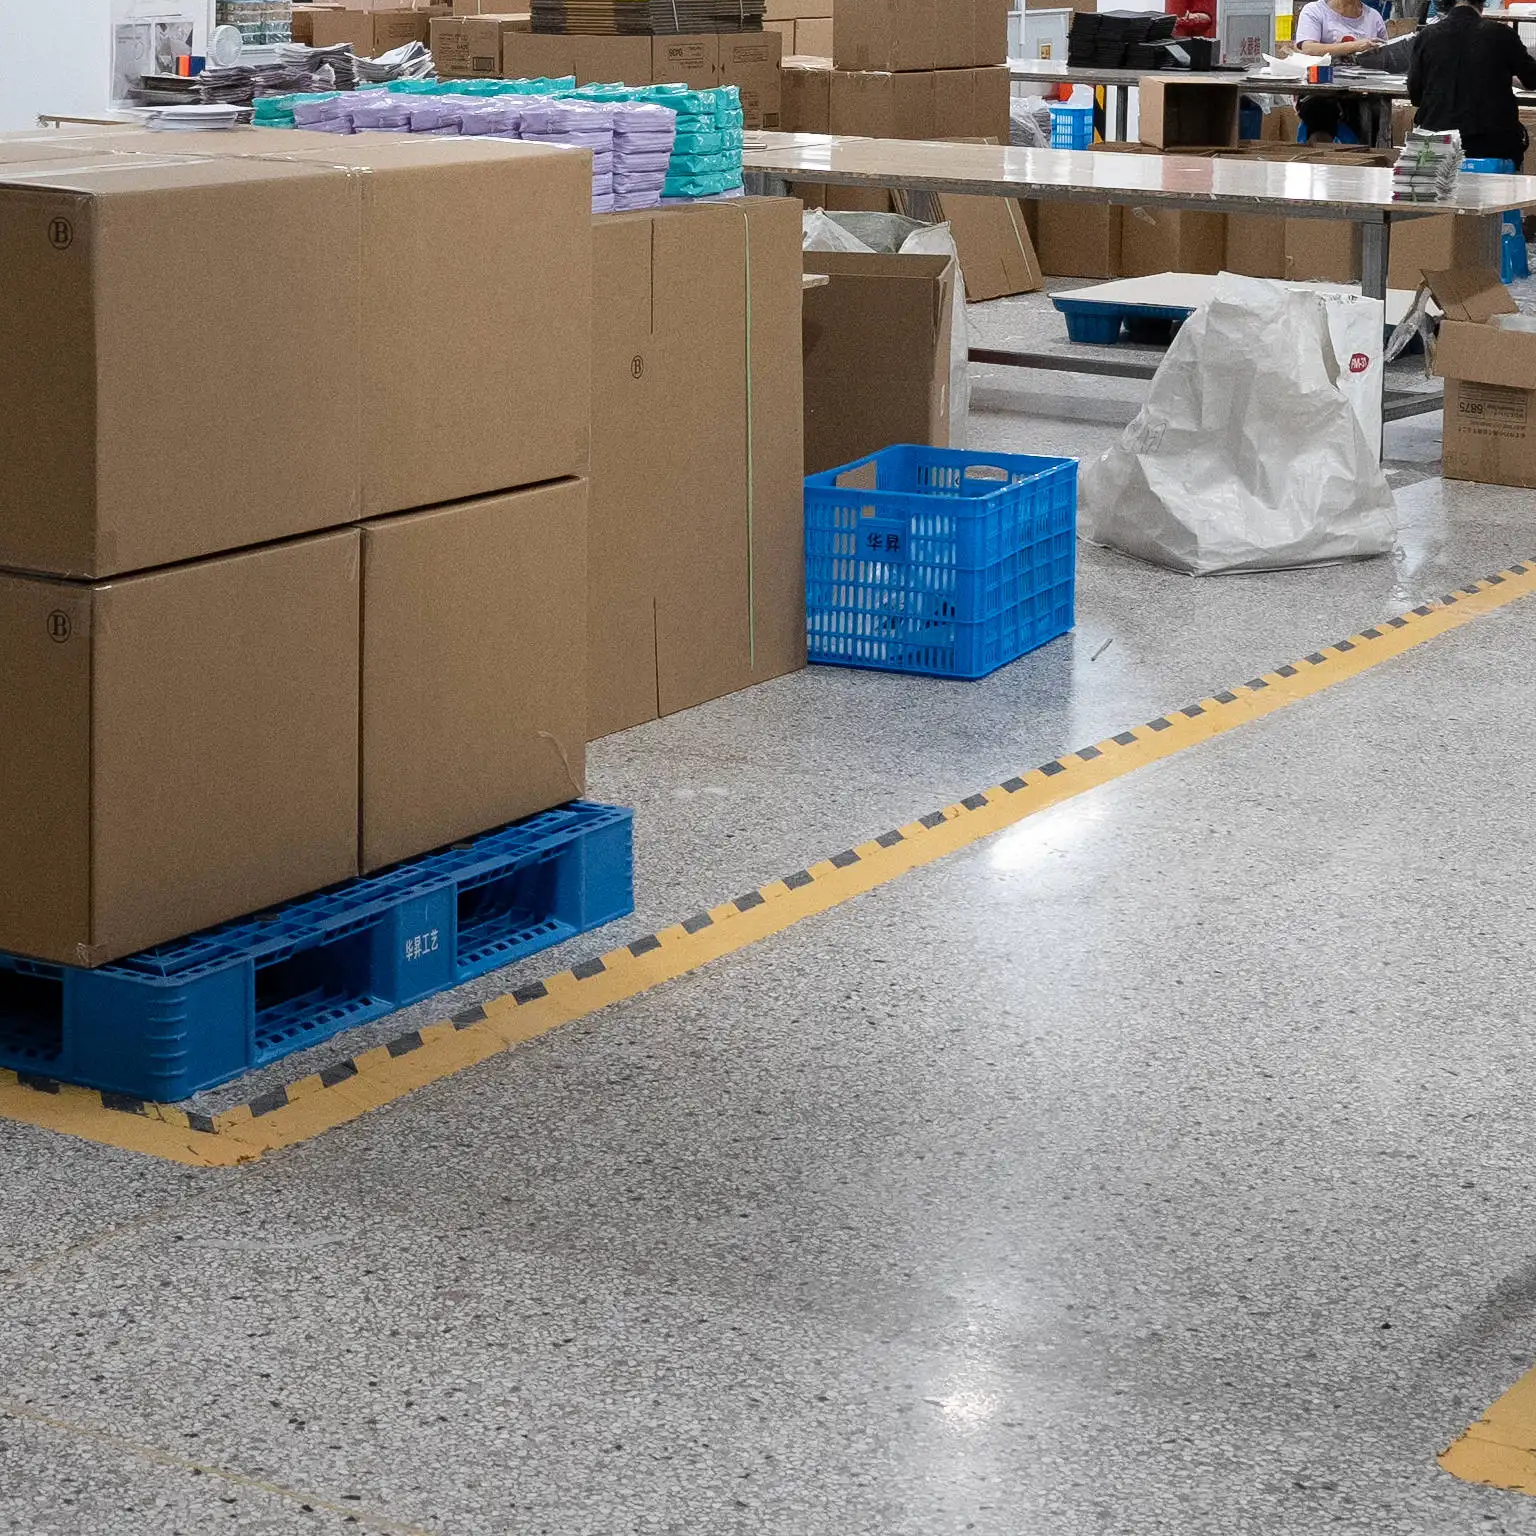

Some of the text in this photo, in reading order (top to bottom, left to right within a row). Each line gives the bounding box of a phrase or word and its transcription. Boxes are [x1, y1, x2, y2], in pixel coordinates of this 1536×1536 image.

[1459, 402, 1483, 415] 6875
[866, 532, 900, 552] 华昇
[405, 928, 440, 962] 华昇工艺
